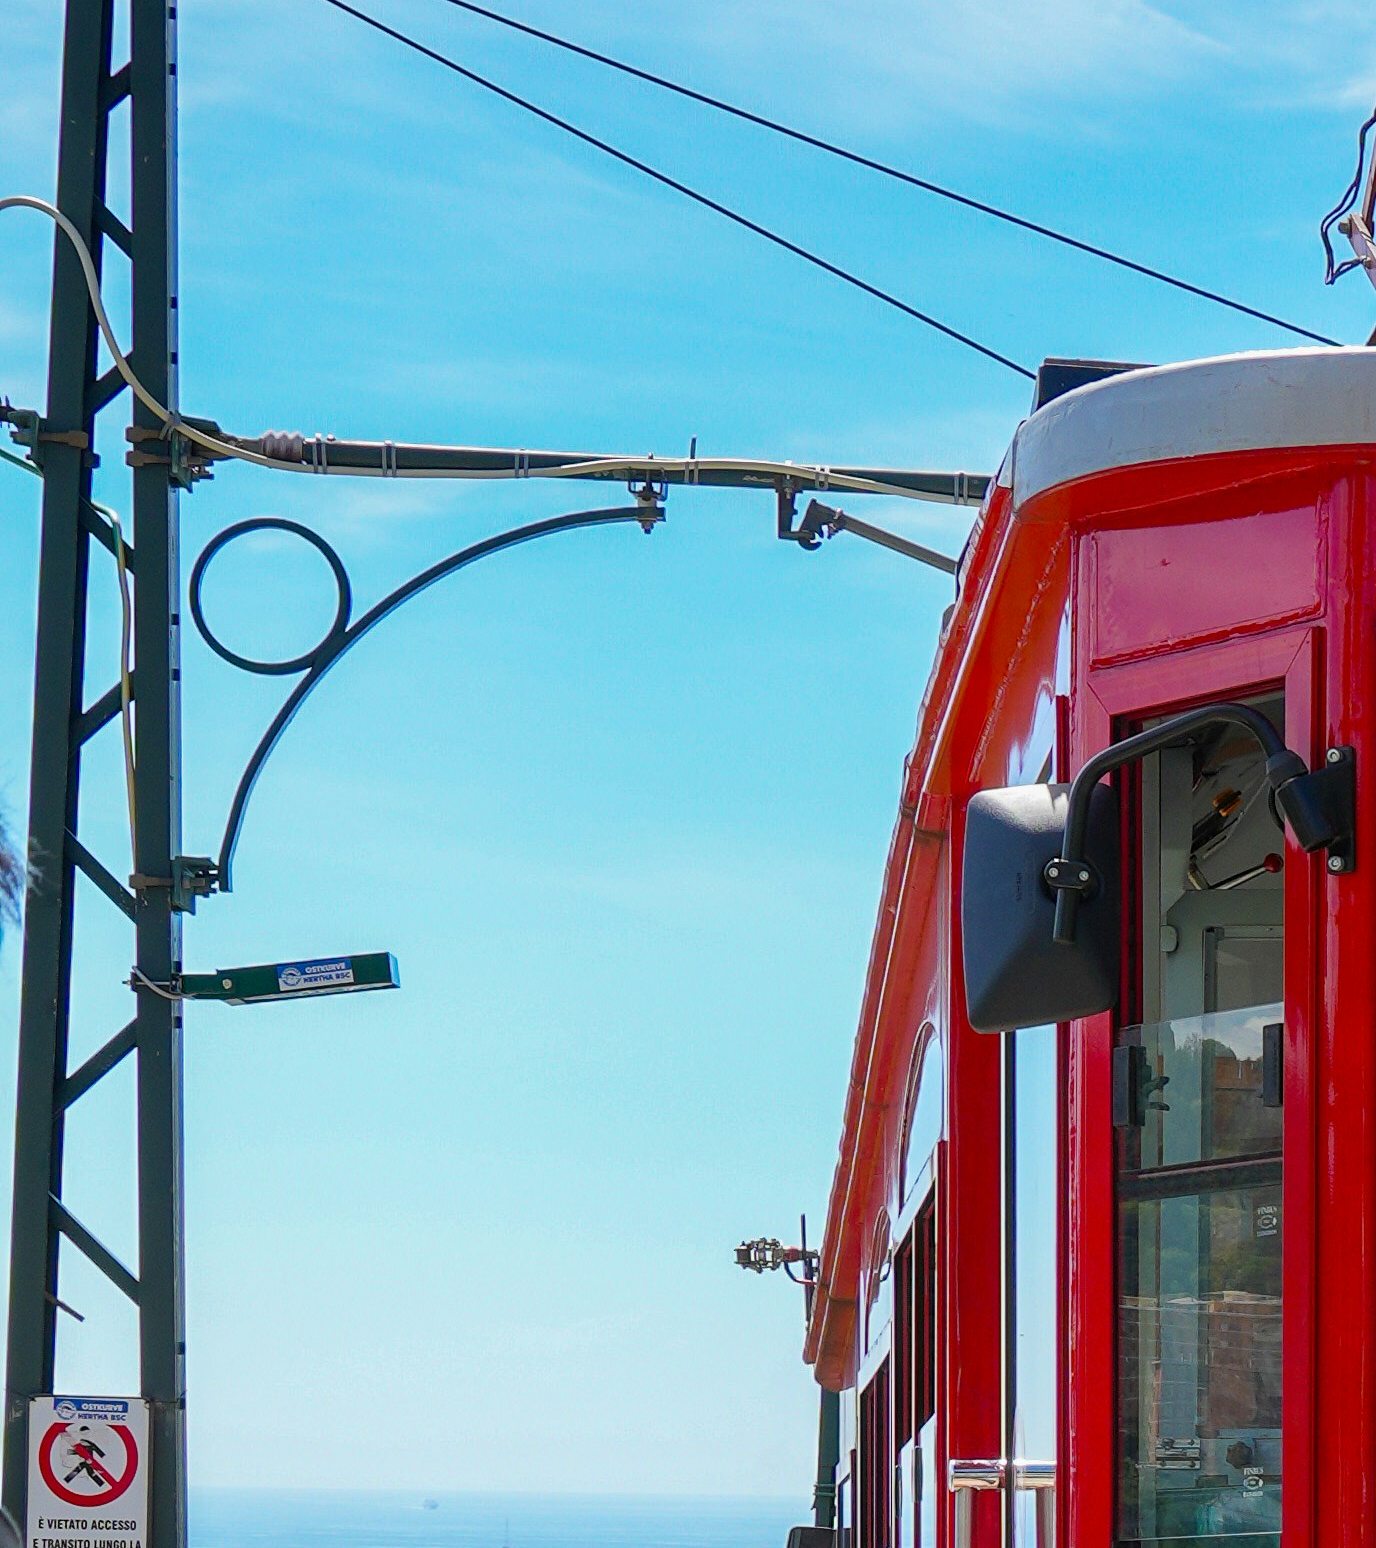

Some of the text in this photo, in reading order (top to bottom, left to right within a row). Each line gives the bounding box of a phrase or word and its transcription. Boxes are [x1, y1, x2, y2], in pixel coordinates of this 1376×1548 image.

[47, 1518, 88, 1530] VIETATO
[90, 1519, 137, 1531] ACCESSO
[32, 1538, 39, 1548] E
